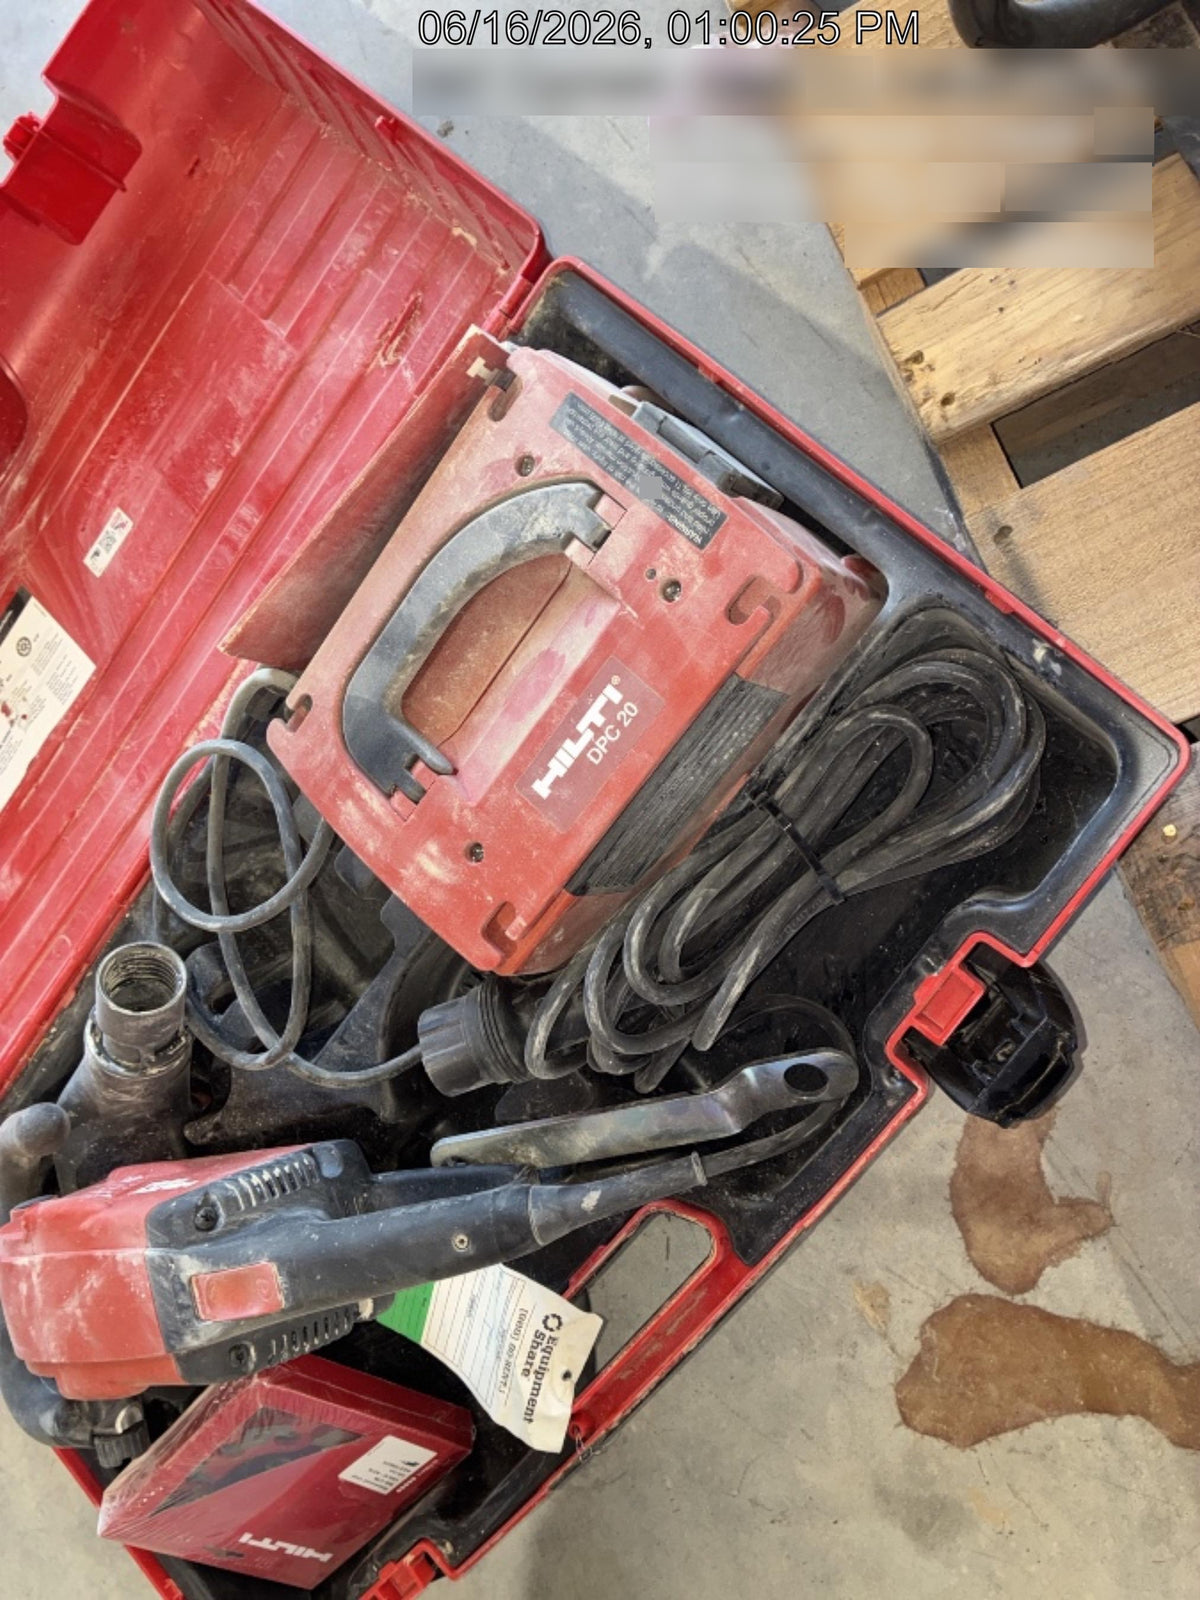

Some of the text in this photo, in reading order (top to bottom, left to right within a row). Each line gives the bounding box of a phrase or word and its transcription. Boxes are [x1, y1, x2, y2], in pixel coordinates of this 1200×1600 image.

[531, 683, 624, 800] HILTI
[586, 701, 639, 766] DPC 20
[520, 1328, 547, 1378] Share
[523, 1334, 559, 1425] Equipment
[239, 1532, 334, 1562] HILTI
